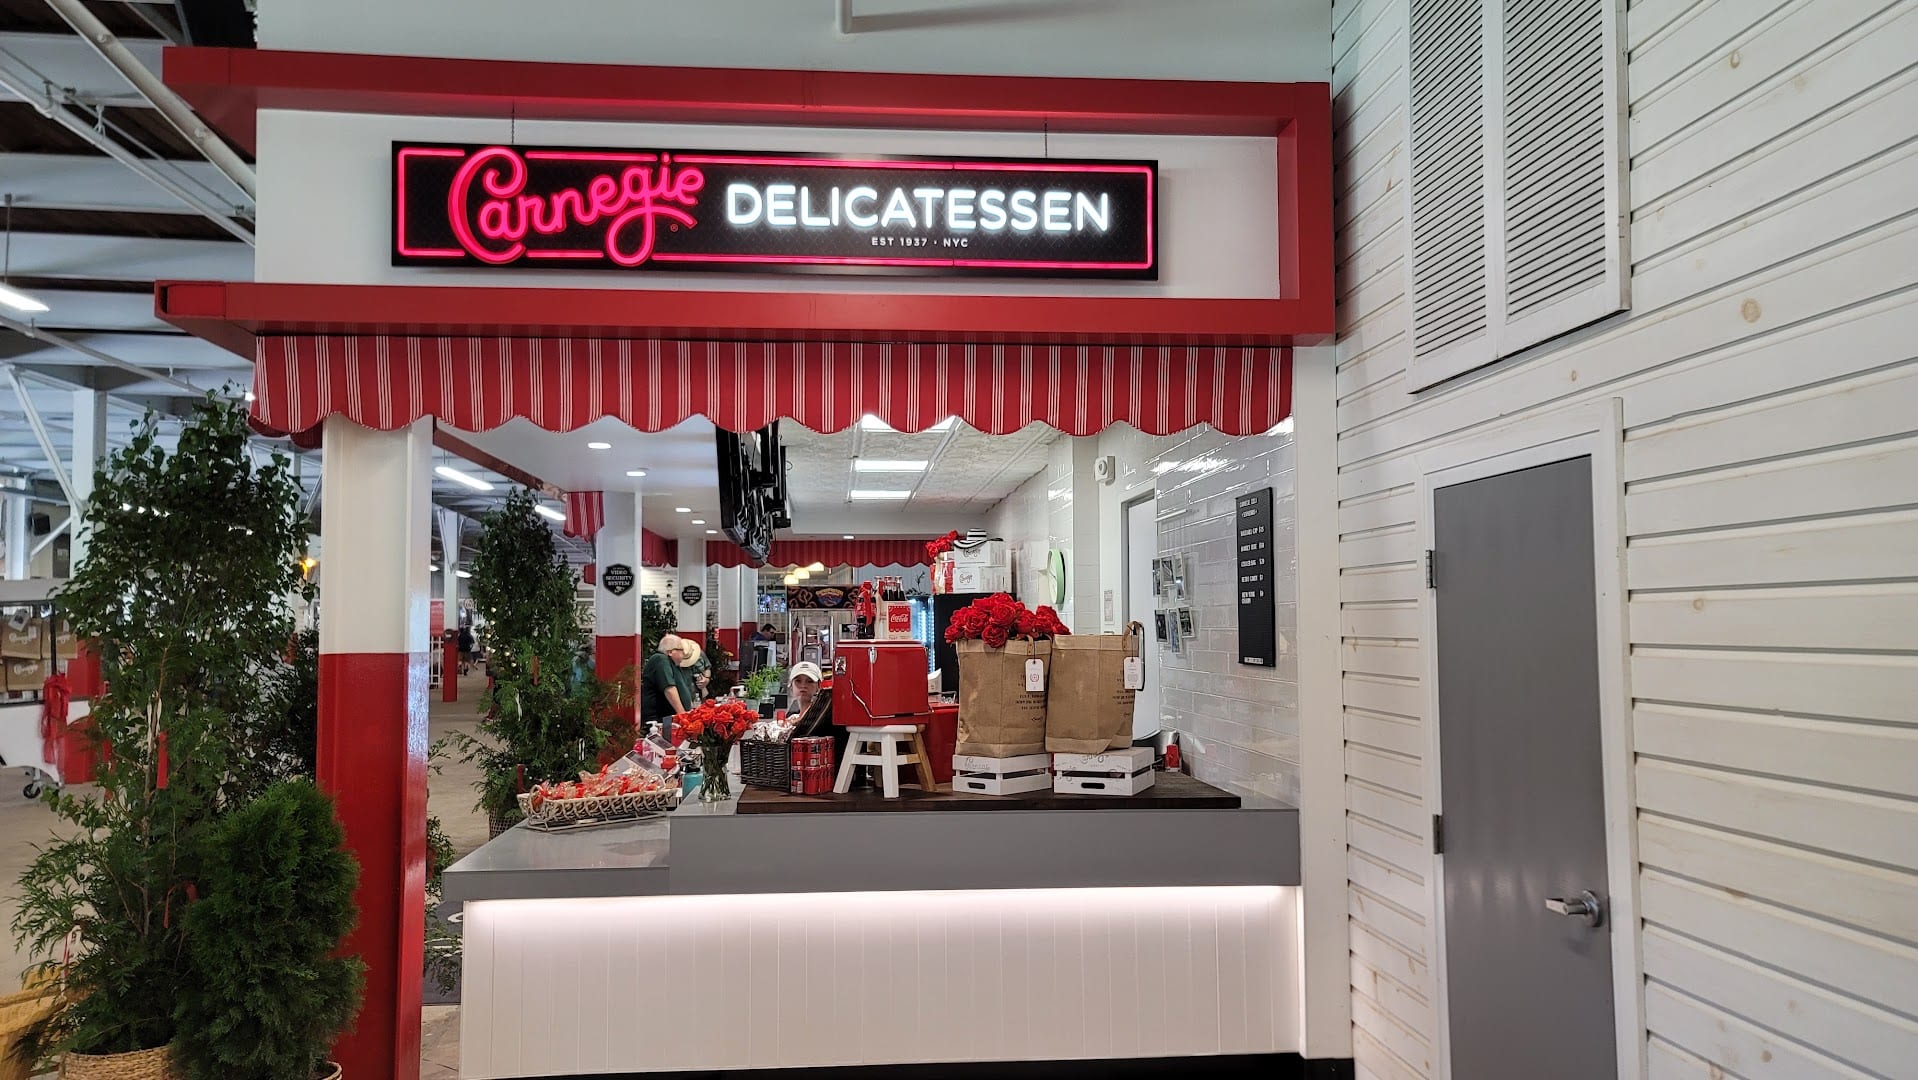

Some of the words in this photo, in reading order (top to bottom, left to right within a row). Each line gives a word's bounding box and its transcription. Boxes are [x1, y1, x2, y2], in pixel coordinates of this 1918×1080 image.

[447, 146, 706, 267] Carnegie
[726, 182, 1110, 232] DELICATESSEN
[871, 236, 894, 246] EST
[899, 236, 928, 247] 1937
[943, 237, 969, 248] NYC
